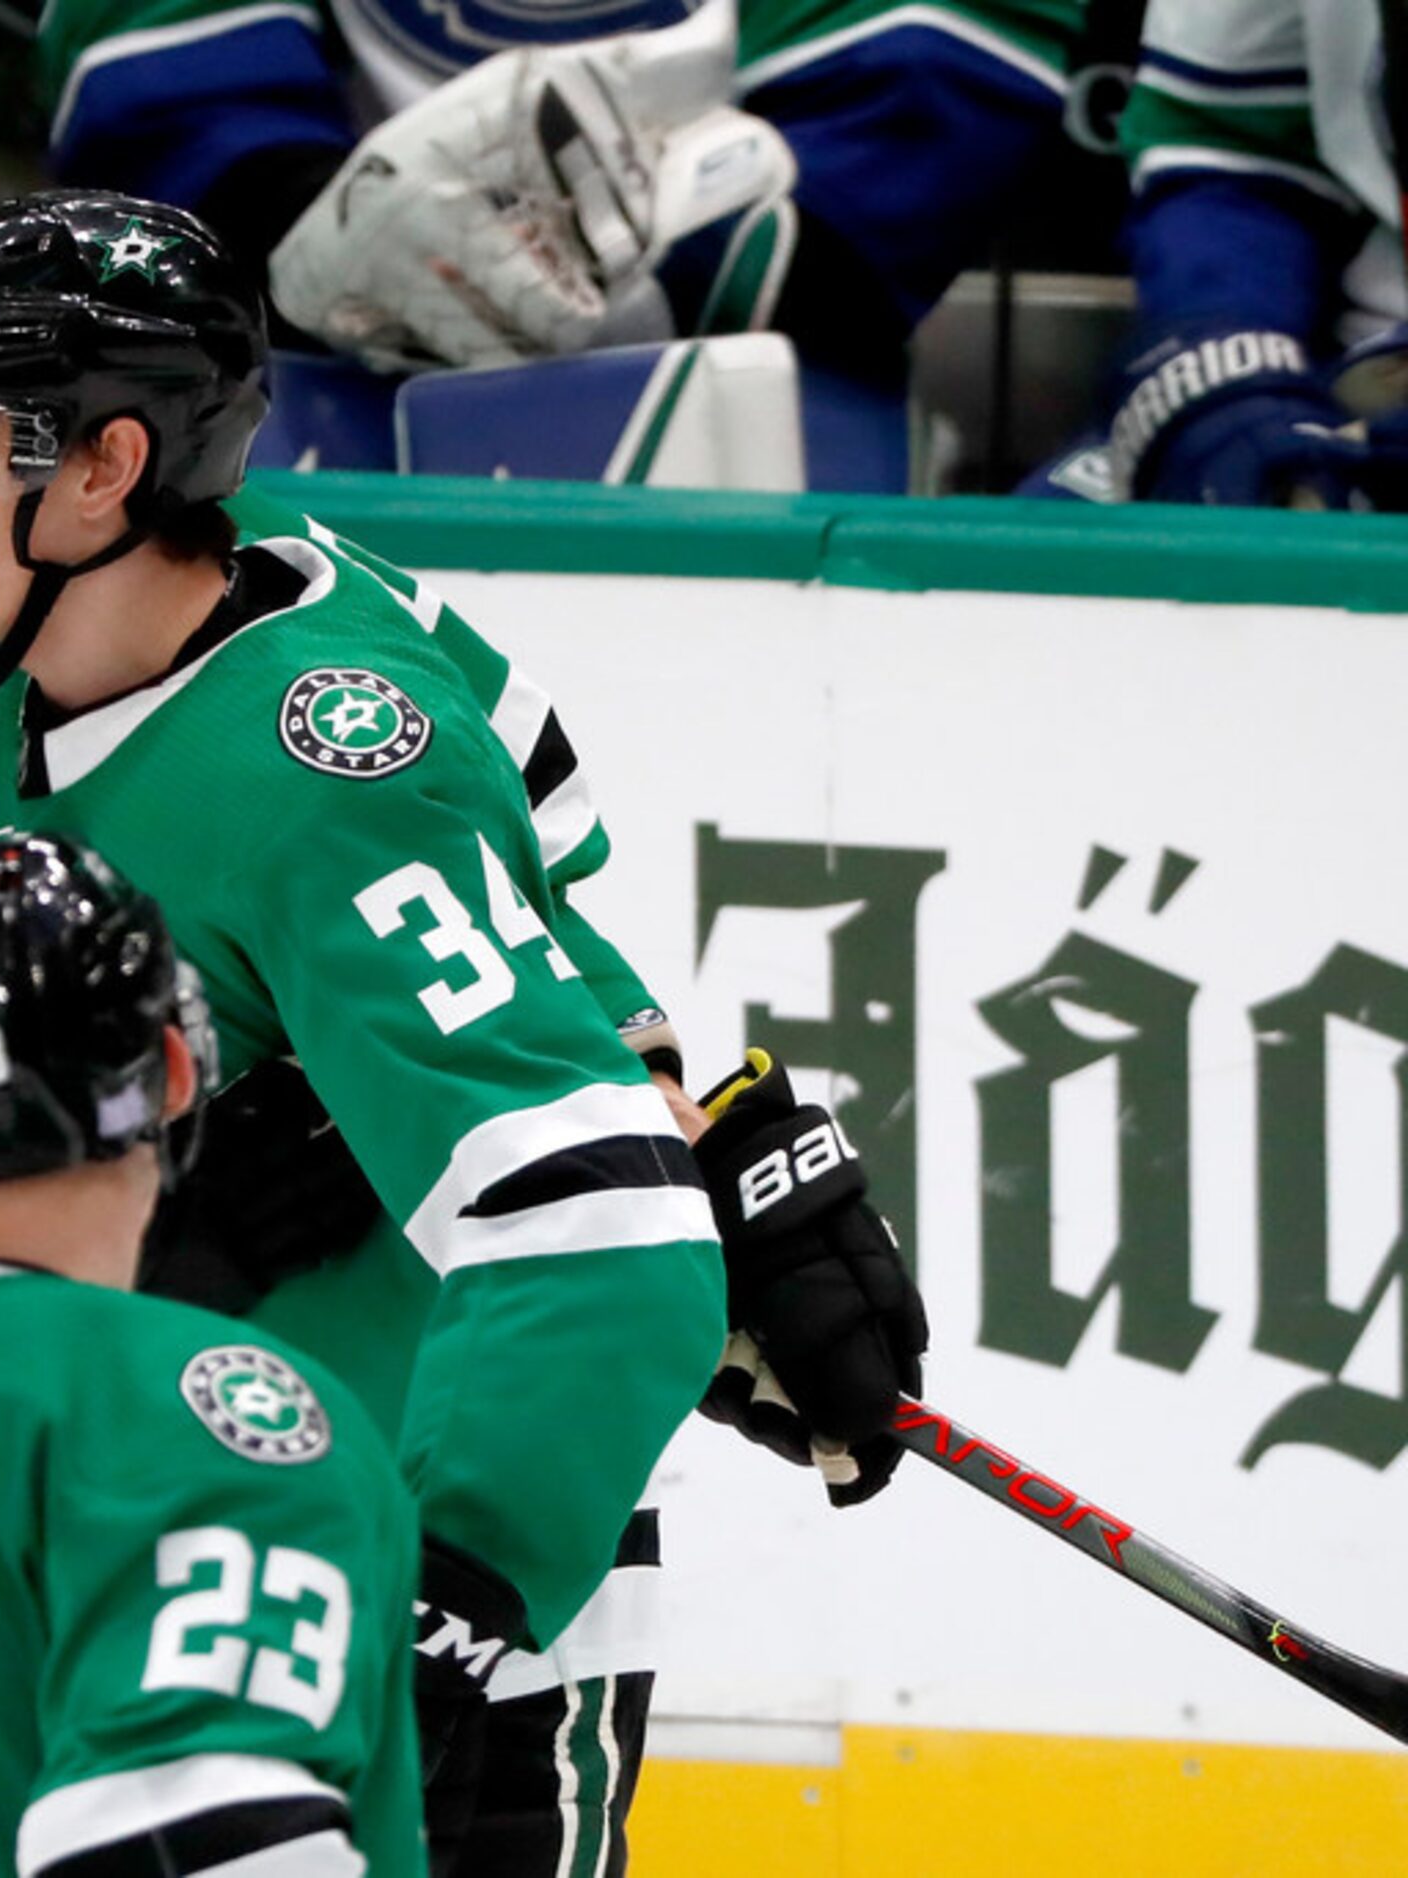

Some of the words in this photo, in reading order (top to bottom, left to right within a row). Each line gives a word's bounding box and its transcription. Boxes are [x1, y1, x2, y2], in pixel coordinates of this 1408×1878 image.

[289, 673, 404, 733] DALLAS
[316, 721, 422, 768] STARS
[351, 829, 582, 1036] 34
[141, 1526, 353, 1732] 23
